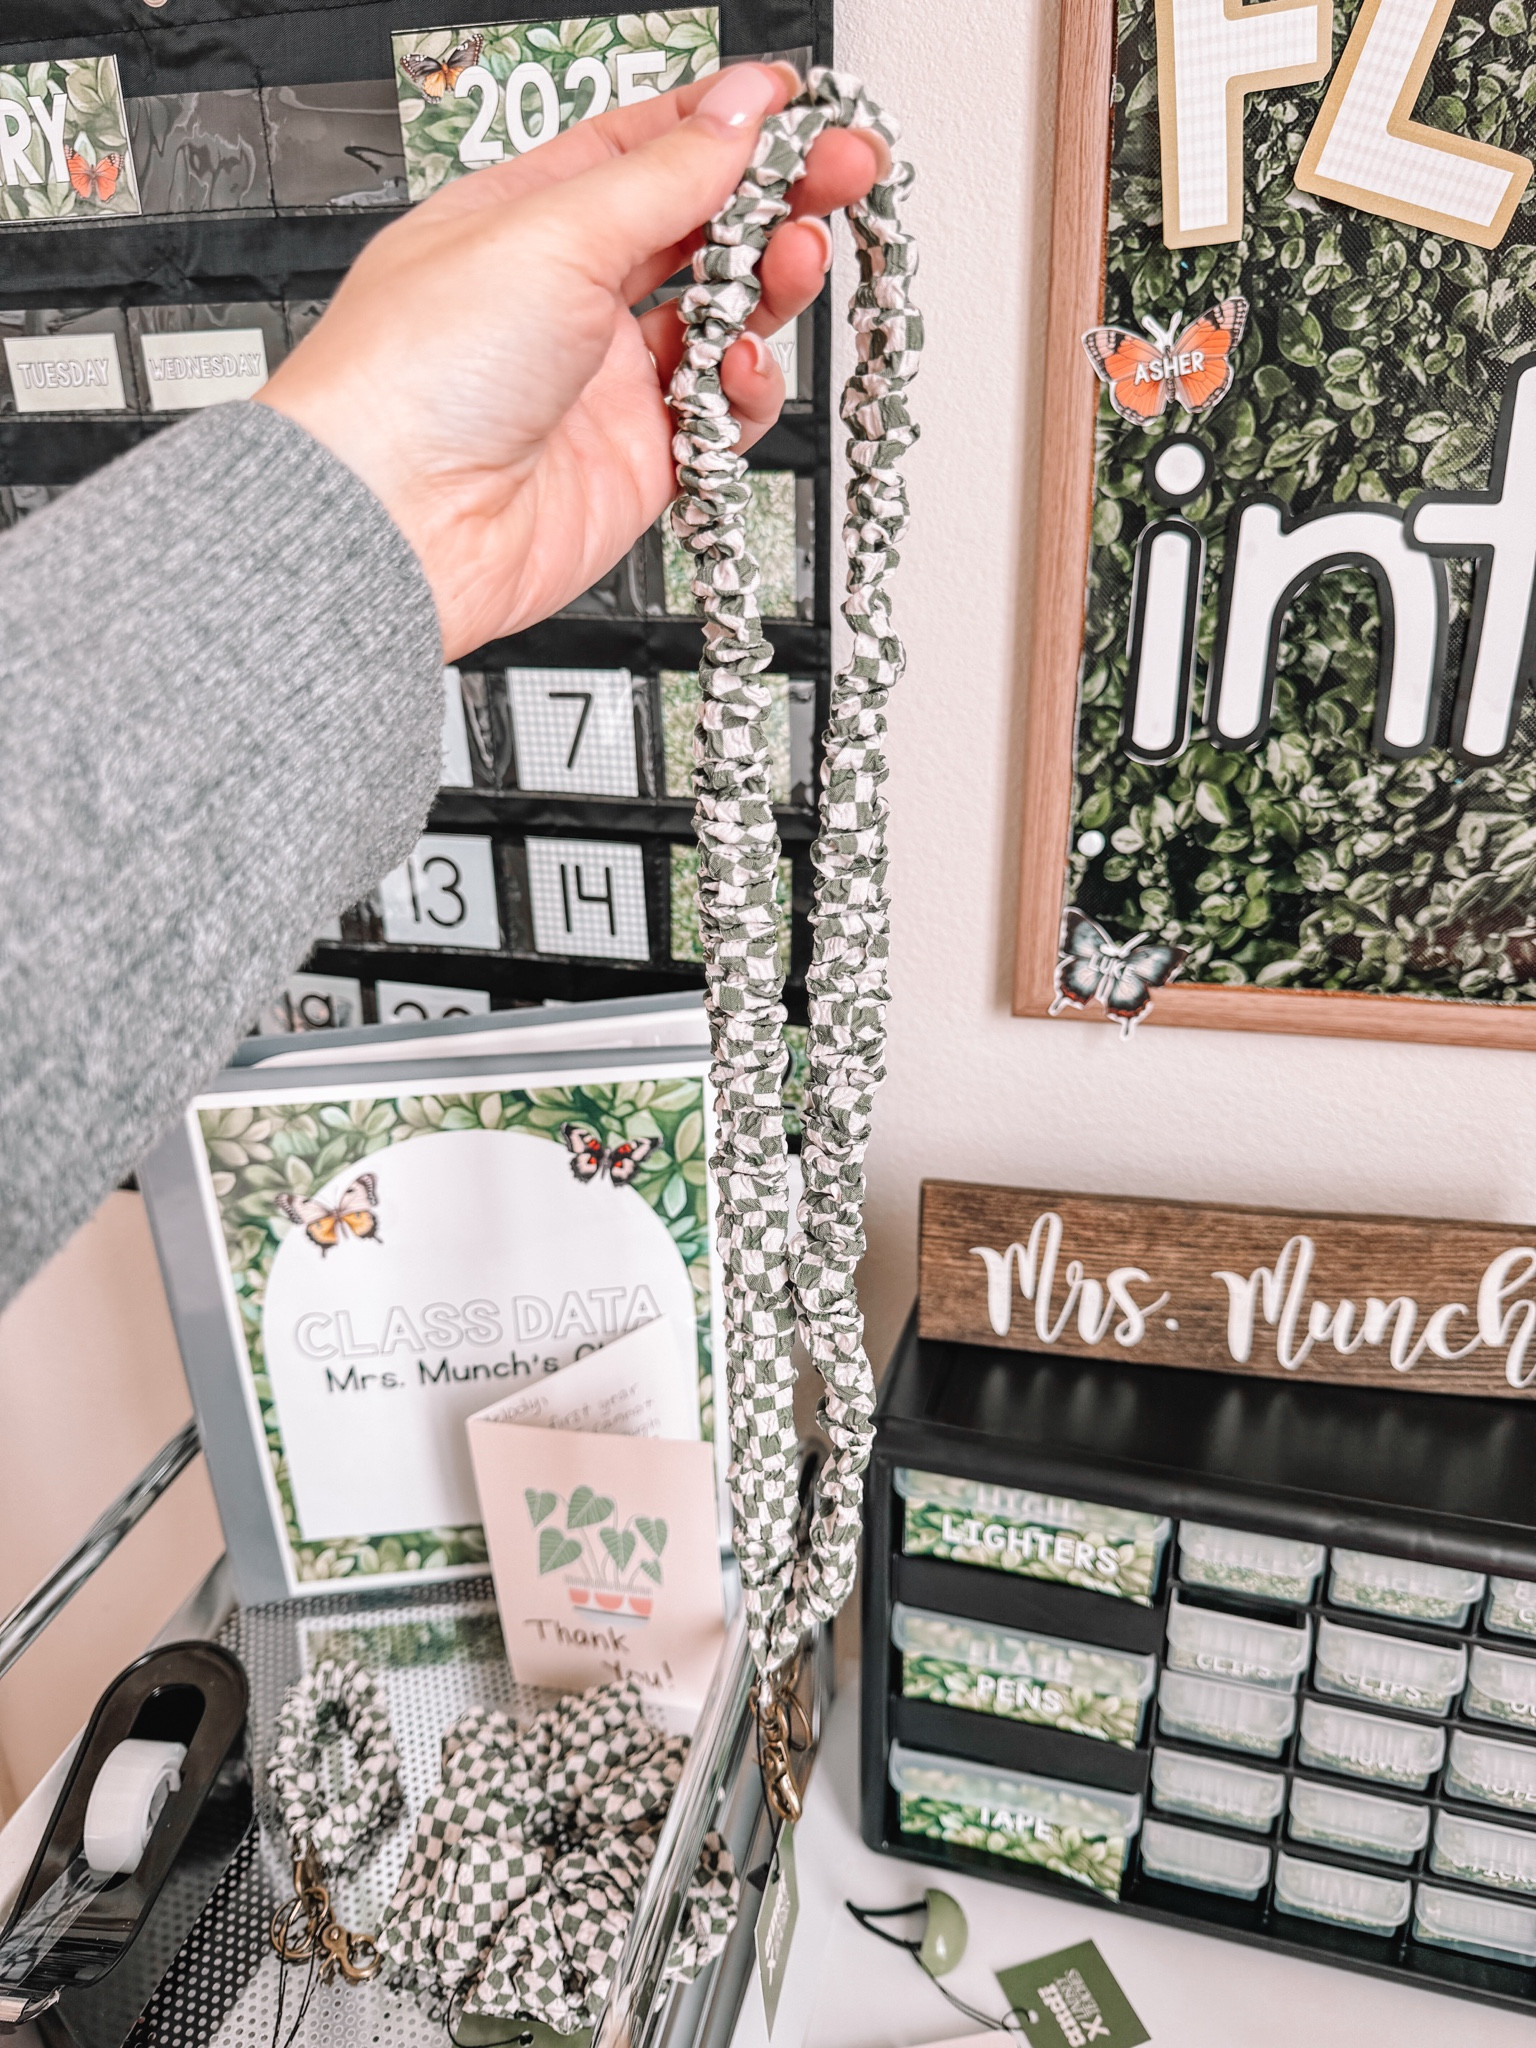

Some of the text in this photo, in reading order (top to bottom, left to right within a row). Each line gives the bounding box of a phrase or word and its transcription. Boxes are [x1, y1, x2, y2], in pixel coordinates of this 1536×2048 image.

[16, 358, 110, 389] TUESDAY
[149, 353, 263, 381] WEDNESDAY
[1133, 350, 1206, 387] ASHER
[548, 691, 593, 769] 7
[406, 856, 467, 928] 13
[559, 863, 617, 936] 14
[968, 1211, 1180, 1348] Mrs.
[294, 1284, 662, 1362] CLASS DATA
[324, 1363, 406, 1394] Mrs.
[418, 1350, 560, 1386] Munch's
[941, 1513, 1122, 1578] LIGHTERS
[523, 1618, 631, 1652] Thank
[1196, 1653, 1273, 1679] CLIPS
[976, 1674, 1064, 1715] PENS
